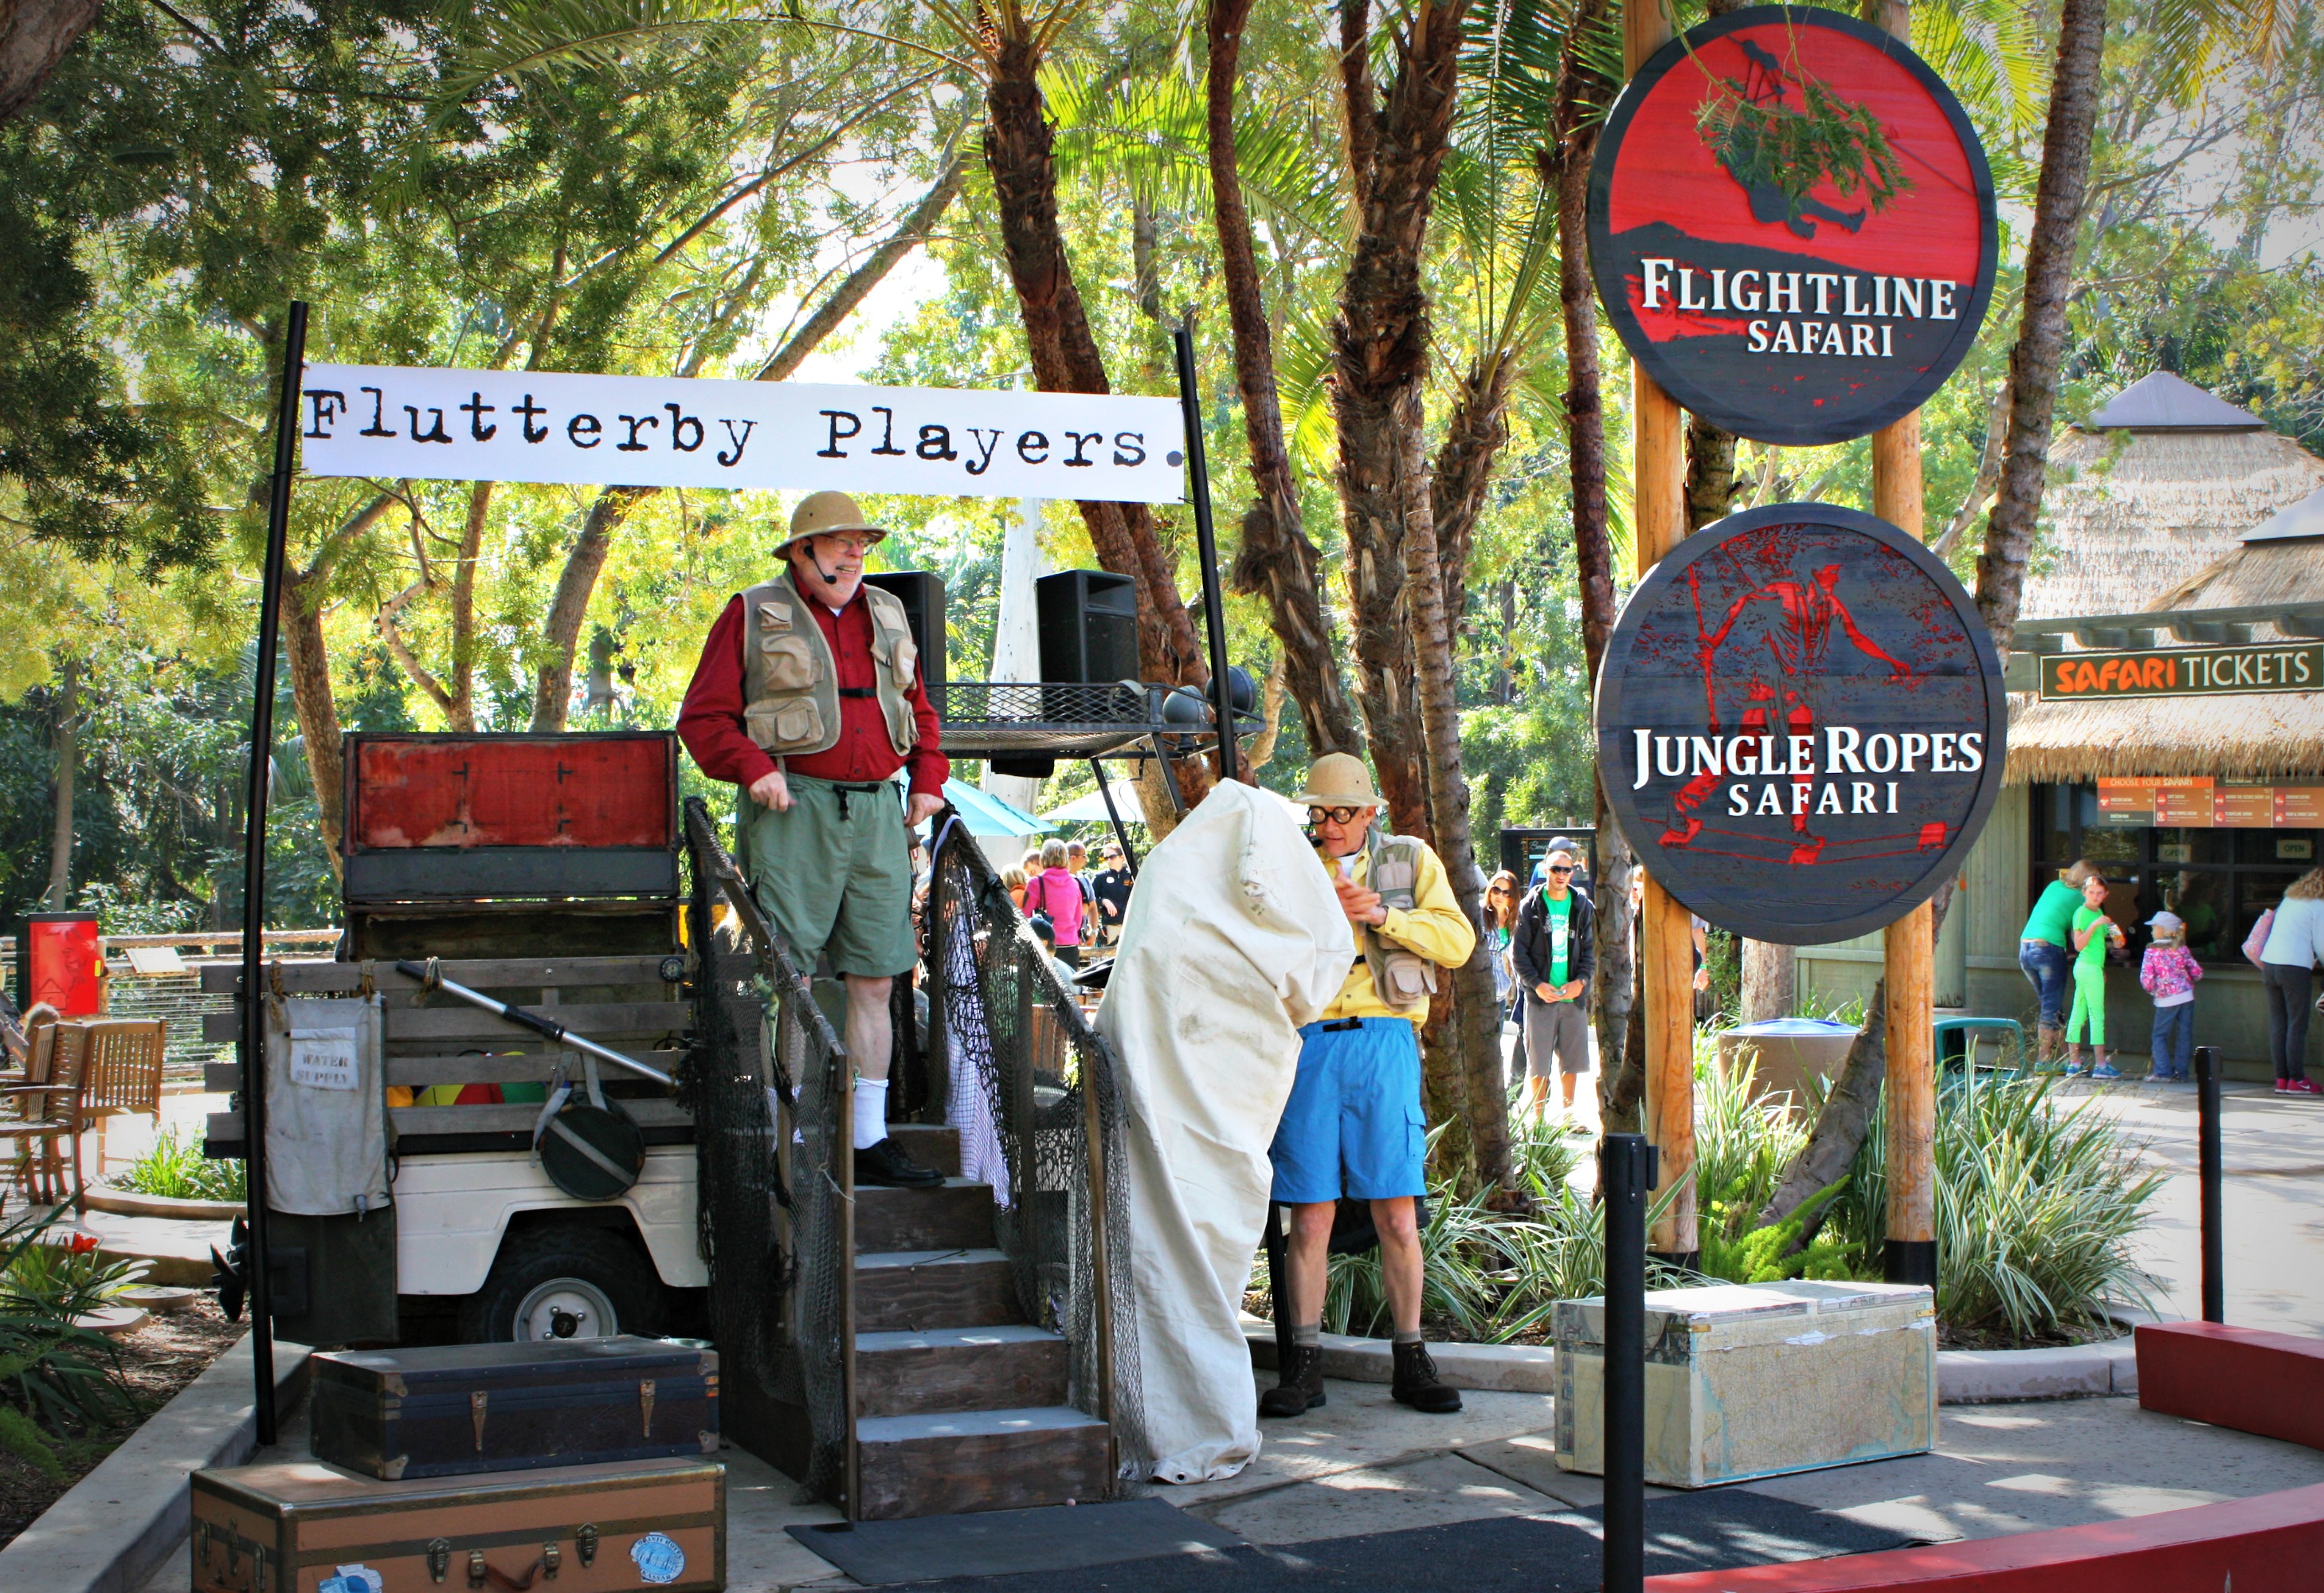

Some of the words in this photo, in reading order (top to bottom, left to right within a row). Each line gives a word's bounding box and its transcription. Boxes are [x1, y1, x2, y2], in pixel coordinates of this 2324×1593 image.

[1640, 258, 1957, 320] FLIGHTLINE
[1747, 320, 1893, 357] SAFARI
[302, 387, 758, 467] Flutterby
[817, 406, 1184, 476] Players.
[2055, 657, 2176, 693] SAFARI
[2181, 652, 2310, 687] TICKETS
[1632, 728, 1815, 791] JUNGLE
[1824, 726, 1982, 775] ROPES
[1728, 782, 1899, 817] SAFARI
[2163, 778, 2193, 787] SAFARI
[296, 1070, 349, 1085] SUPPLY
[303, 1053, 349, 1068] WATER
